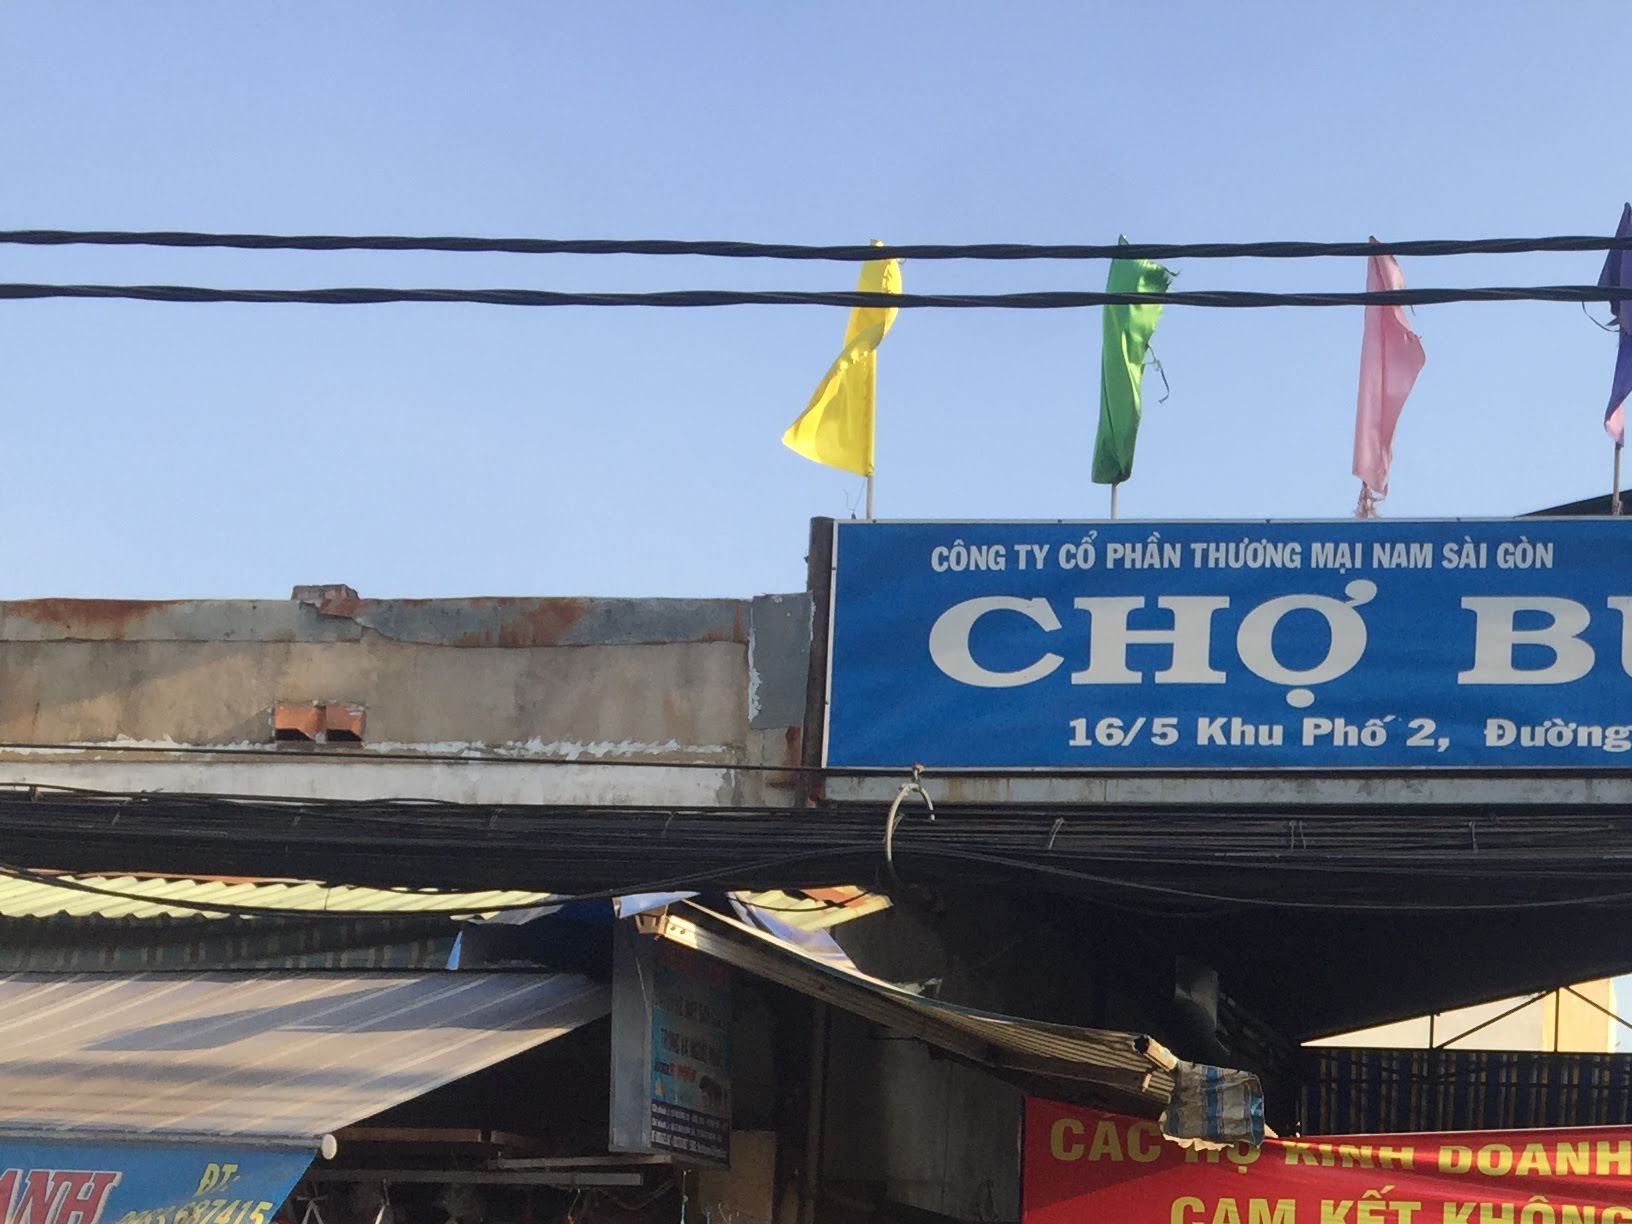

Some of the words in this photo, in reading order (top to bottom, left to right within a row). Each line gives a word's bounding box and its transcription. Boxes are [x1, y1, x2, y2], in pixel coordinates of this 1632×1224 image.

[931, 539, 1006, 572] CÔNG
[1014, 543, 1050, 570] TY
[1058, 530, 1098, 570] CỔ
[1106, 531, 1181, 569] PHẦN
[1190, 537, 1302, 569] THƯƠNG
[1311, 542, 1362, 574] MẠI
[1372, 543, 1433, 569] NAM
[1442, 536, 1487, 569] SÀI
[1496, 536, 1553, 569] GÒN
[928, 579, 1377, 708] CHỢ
[1067, 717, 1179, 746] 16/5
[1198, 717, 1283, 746] Khu
[1303, 715, 1395, 747] Phố
[1406, 718, 1450, 752] 2,
[1484, 718, 1632, 752] Đường
[1438, 1140, 1632, 1176] DOANH
